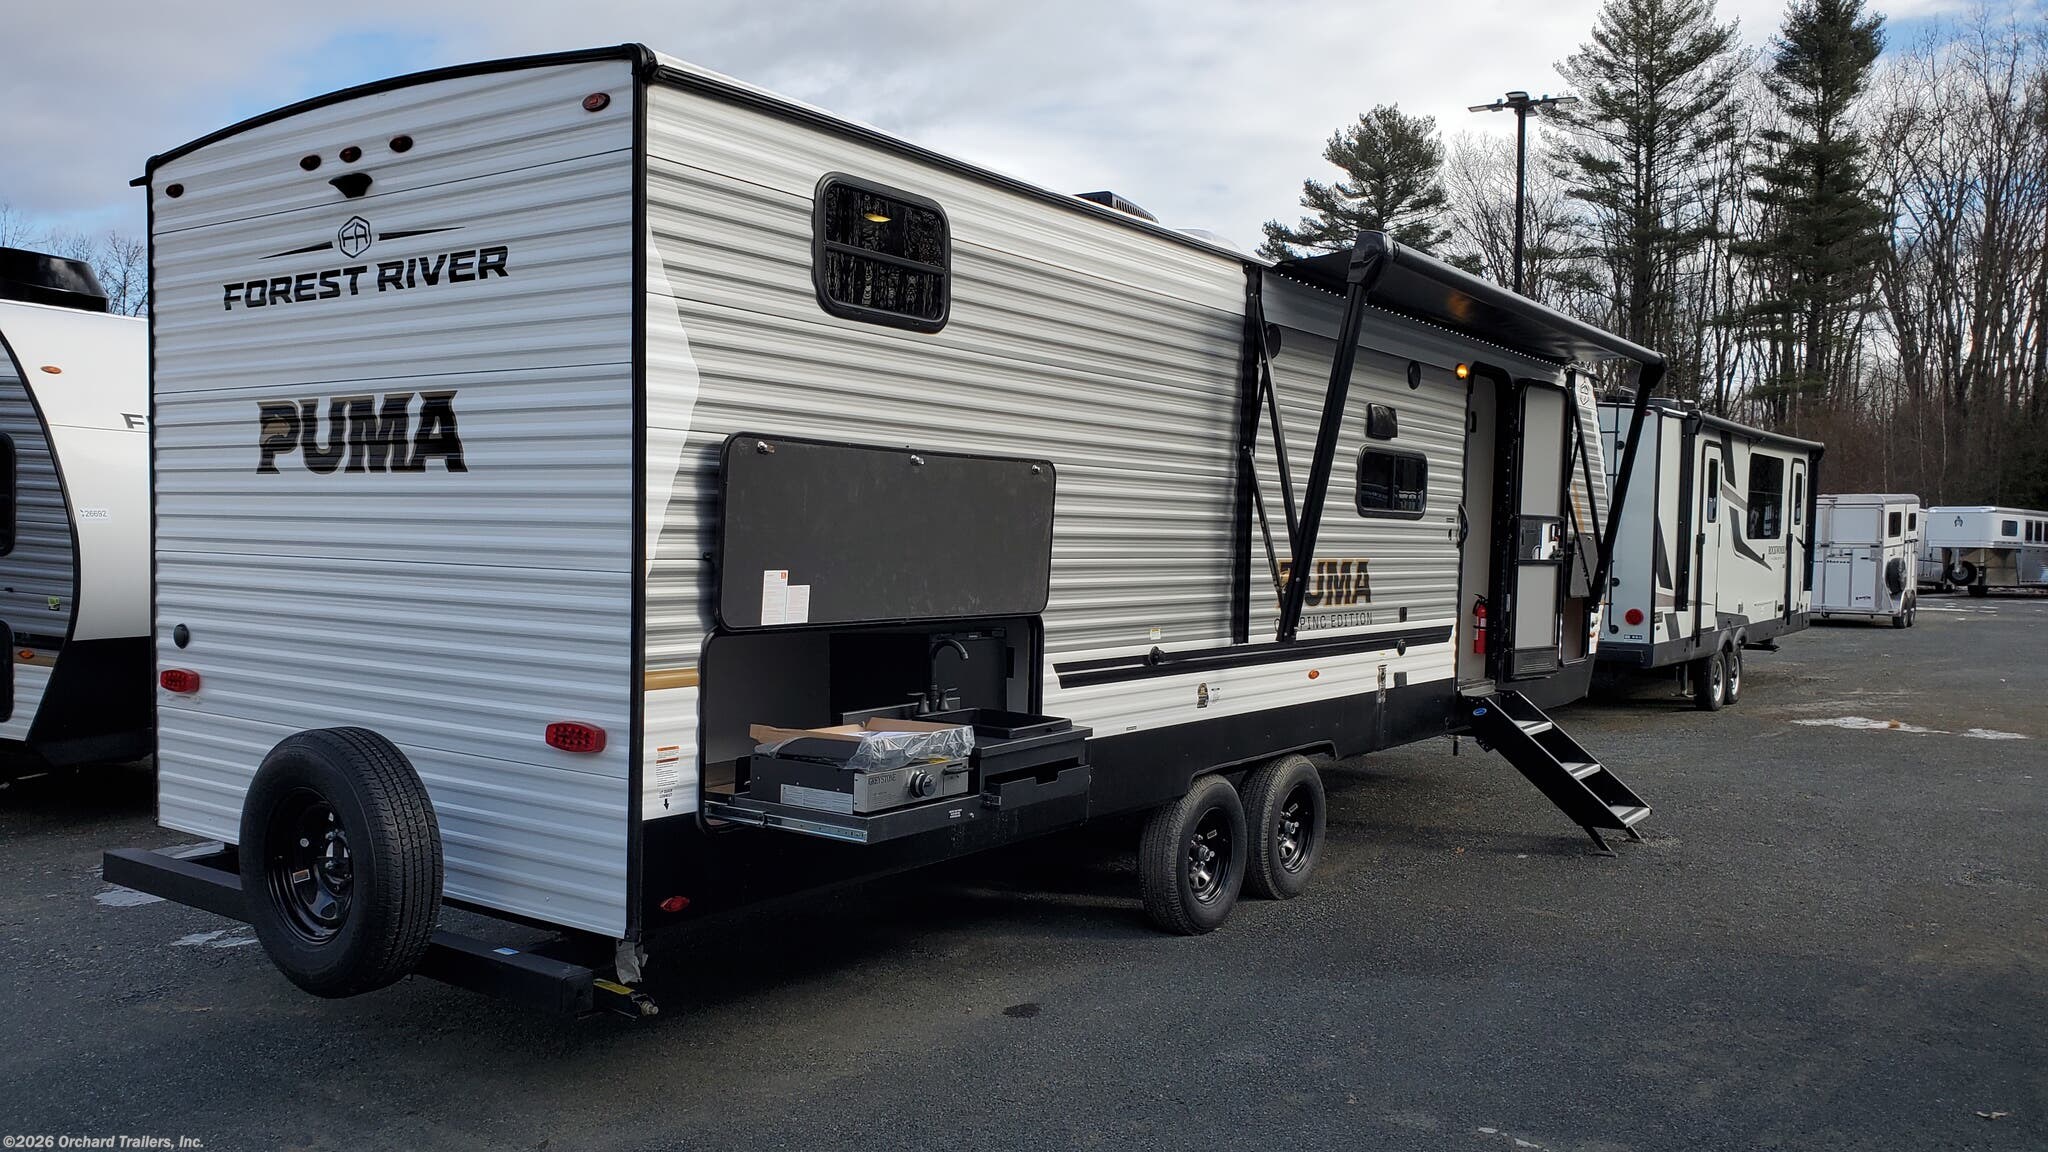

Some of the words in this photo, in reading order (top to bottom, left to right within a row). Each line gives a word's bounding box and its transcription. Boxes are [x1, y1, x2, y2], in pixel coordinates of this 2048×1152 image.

[223, 265, 367, 311] FOREST
[376, 245, 509, 292] RIVER
[256, 389, 469, 475] PUMA
[1274, 615, 1326, 631] CPING
[1331, 612, 1372, 628] EDITION
